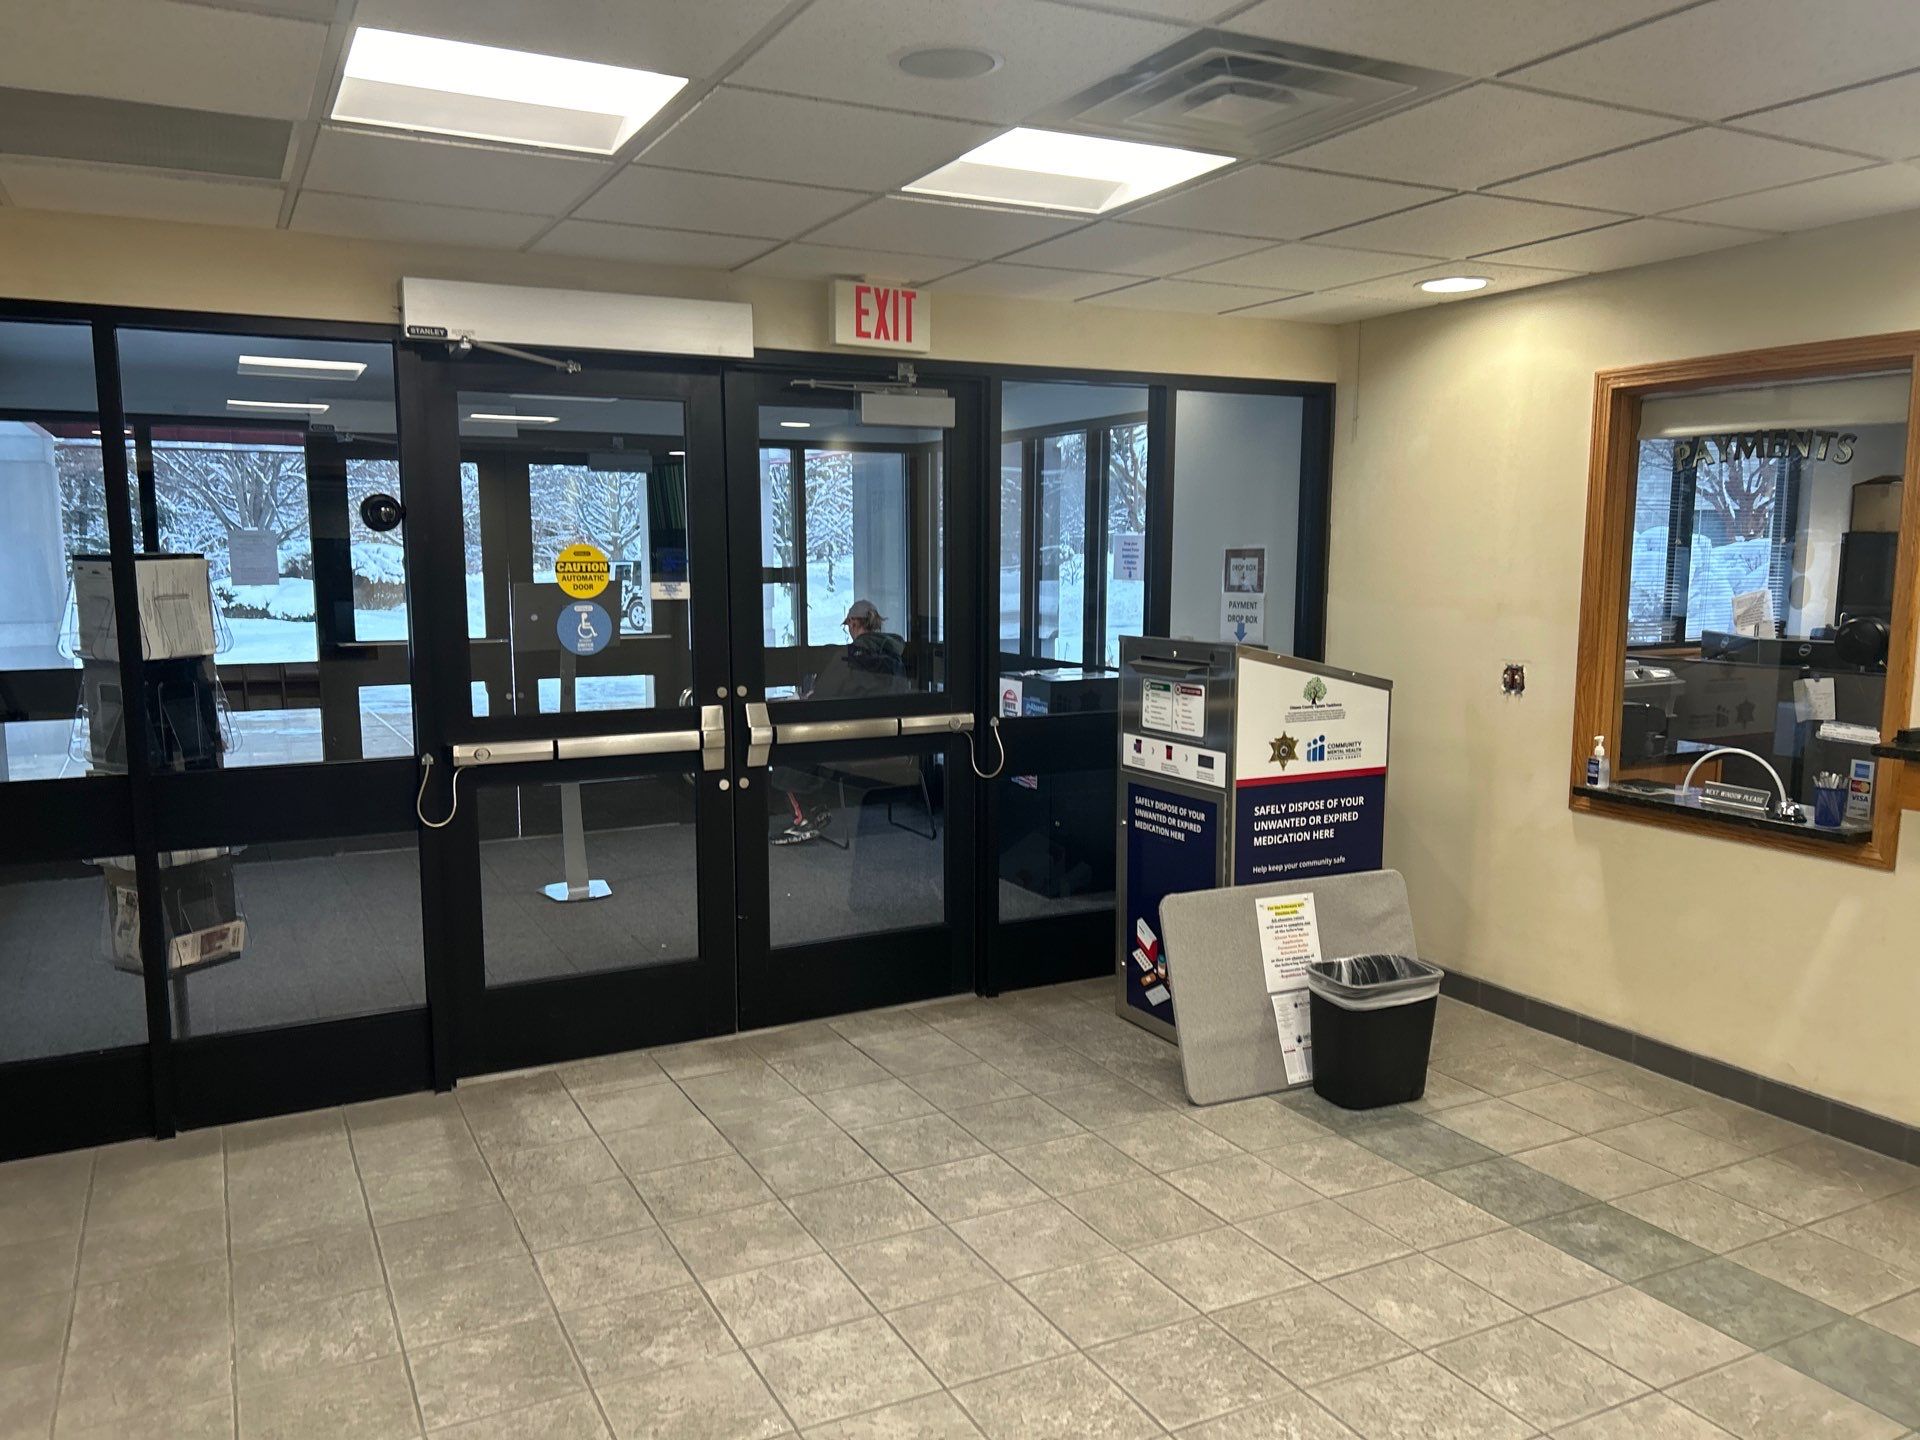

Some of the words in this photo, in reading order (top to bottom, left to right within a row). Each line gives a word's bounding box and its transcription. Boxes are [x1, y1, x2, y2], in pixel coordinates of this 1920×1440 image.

[855, 285, 917, 343] EXIT
[410, 327, 445, 336] STANLEY
[1675, 429, 1858, 473] PAYMENTS
[556, 562, 608, 572] CAUTION
[573, 583, 594, 591] DOOR
[1228, 601, 1258, 610] PAYMENT
[1227, 614, 1244, 623] DROP
[1245, 615, 1258, 624] BOX
[1327, 741, 1362, 750] COMMUNITY
[1705, 788, 1719, 796] NEXT
[1720, 791, 1742, 800] WINDOW
[1742, 795, 1764, 804] PLEASE
[1135, 795, 1154, 807] SAFELY
[1155, 800, 1178, 815] DISPOSE
[1179, 807, 1187, 816] OF
[1188, 809, 1206, 822] YOUR
[1254, 803, 1287, 817] SAFELY
[1288, 800, 1325, 813] DISPOSE
[1326, 798, 1339, 809] OF
[1340, 796, 1365, 807] YOUR
[1135, 807, 1167, 823] UNWANTED
[1167, 817, 1176, 827] OR
[1177, 819, 1202, 834] EXPIRED
[1254, 817, 1307, 831] UNWANTED
[1308, 815, 1322, 826] OR
[1323, 811, 1359, 824] EXPIRED
[1134, 820, 1169, 837] MEDICATION
[1170, 829, 1185, 842] HERE
[1253, 830, 1311, 847] MEDICATION
[1312, 828, 1335, 840] HERE
[1252, 865, 1267, 875] Help
[1268, 863, 1283, 873] keep
[1284, 862, 1298, 872] your
[1299, 856, 1332, 867] community
[1333, 854, 1346, 864] safe
